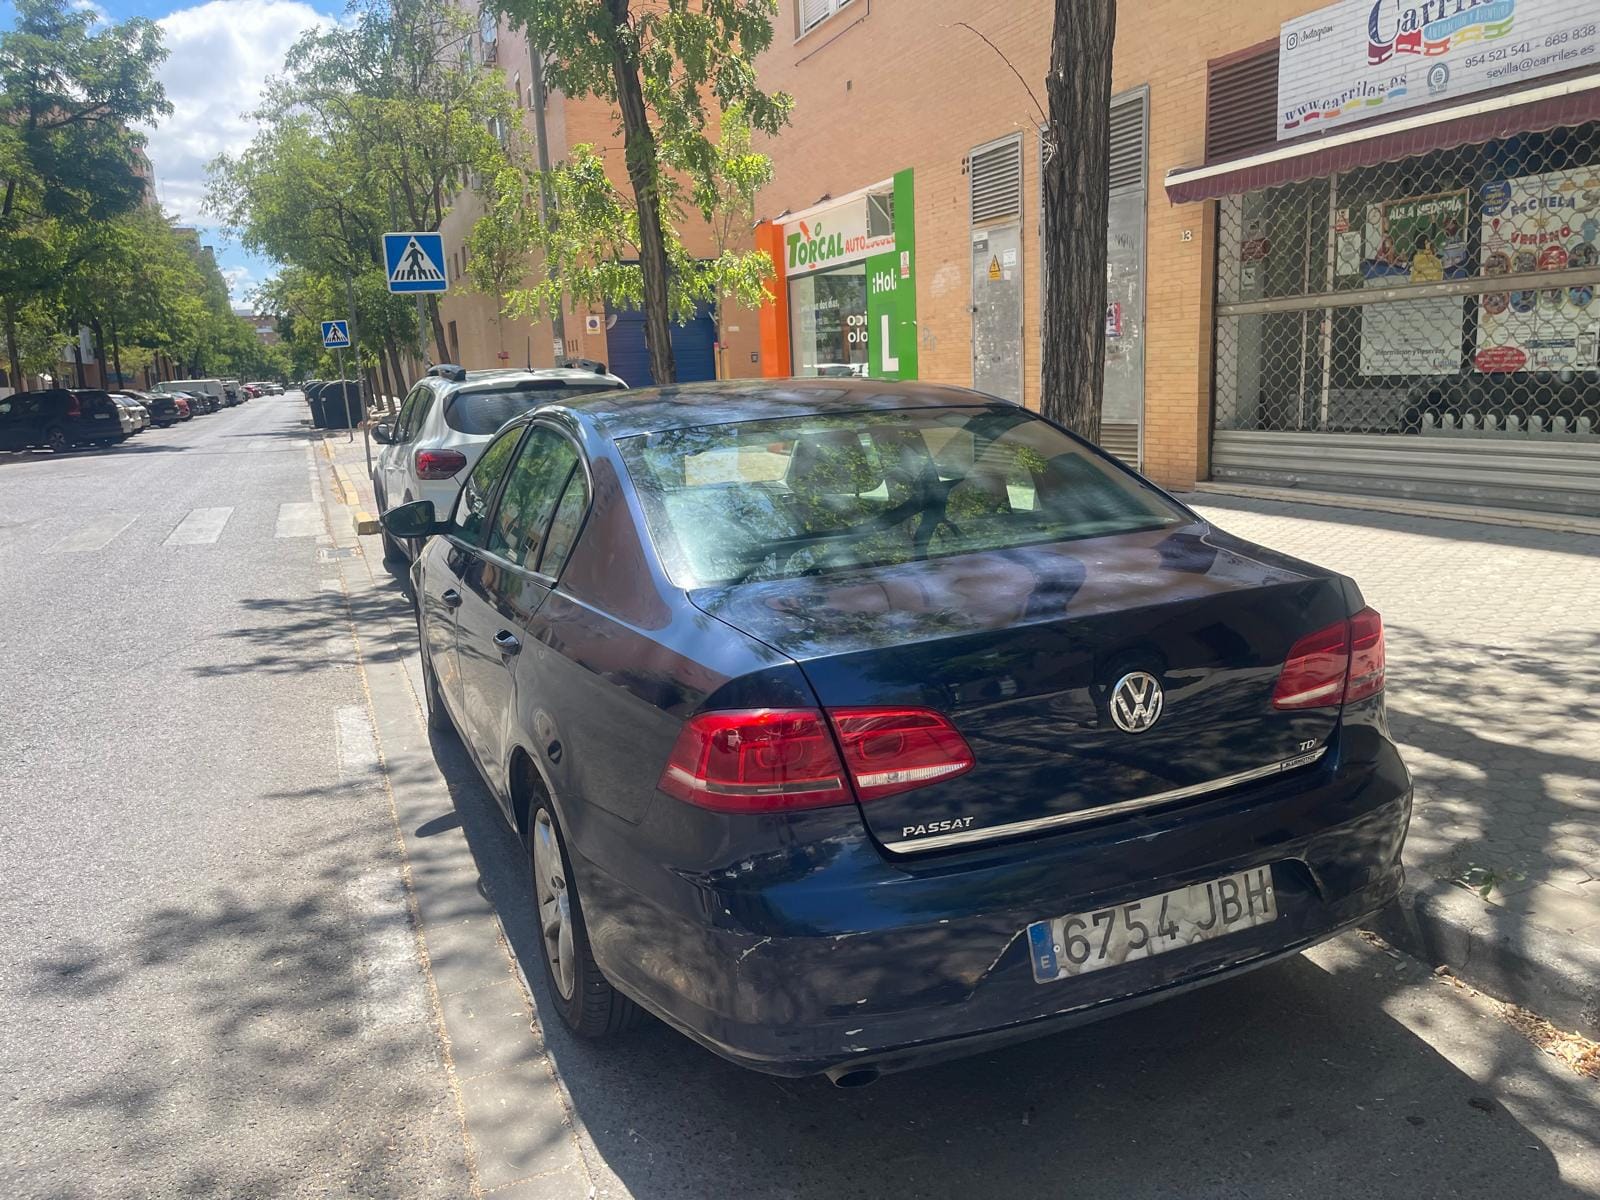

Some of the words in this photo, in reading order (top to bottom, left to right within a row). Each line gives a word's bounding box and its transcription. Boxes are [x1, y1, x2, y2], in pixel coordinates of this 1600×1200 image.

[1465, 55, 1485, 68] 954
[1489, 50, 1507, 62] 521
[1511, 43, 1530, 57] 541
[1572, 24, 1597, 40] 838
[1486, 45, 1595, 79] sevilla@carriles.es
[1284, 75, 1408, 121] www.carriles.es
[787, 232, 844, 268] TORCAL
[1180, 230, 1192, 241] 13
[872, 268, 897, 294] ¡Hol
[881, 315, 899, 371] L
[903, 816, 974, 837] PASSAT
[1063, 895, 1180, 965] 6754
[1196, 869, 1269, 931] JBH
[1041, 955, 1050, 969] E
